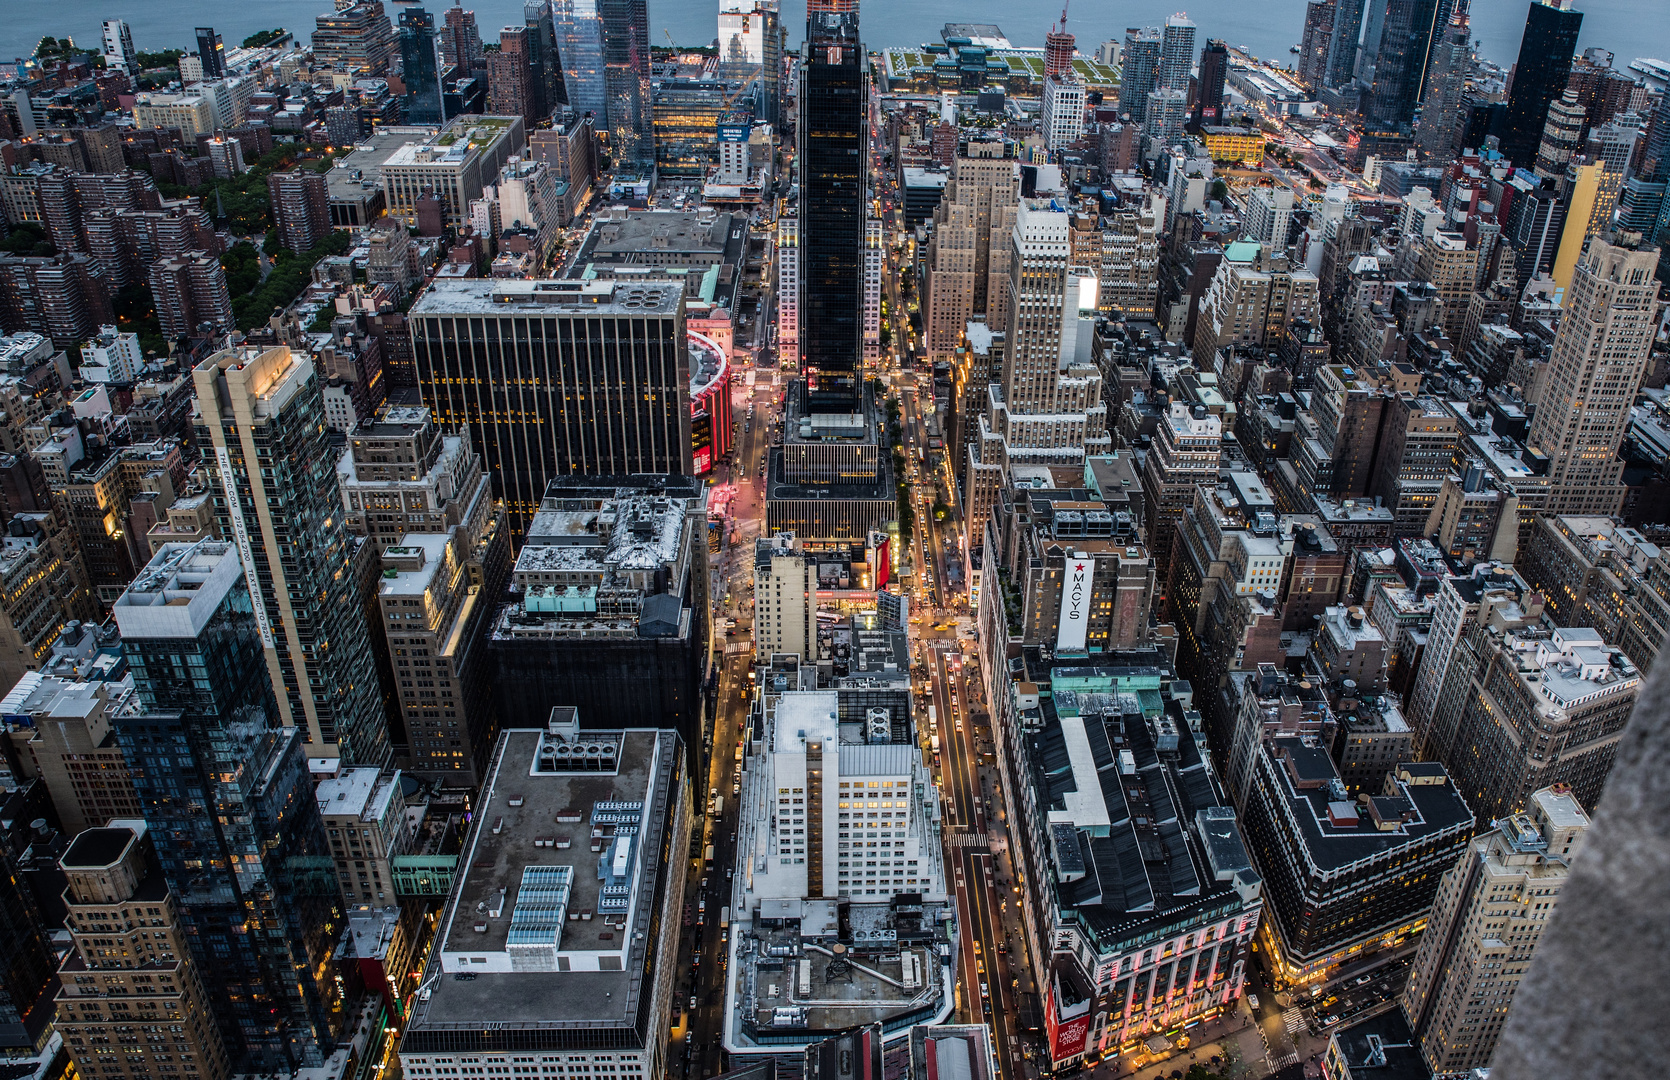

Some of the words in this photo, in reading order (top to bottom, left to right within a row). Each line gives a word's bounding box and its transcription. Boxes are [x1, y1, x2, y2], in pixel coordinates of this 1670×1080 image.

[219, 452, 229, 469] THE
[248, 568, 257, 587] TEXT
[258, 611, 266, 621] TO
[1068, 1022, 1080, 1030] THE
[1062, 1036, 1081, 1046] STORE
